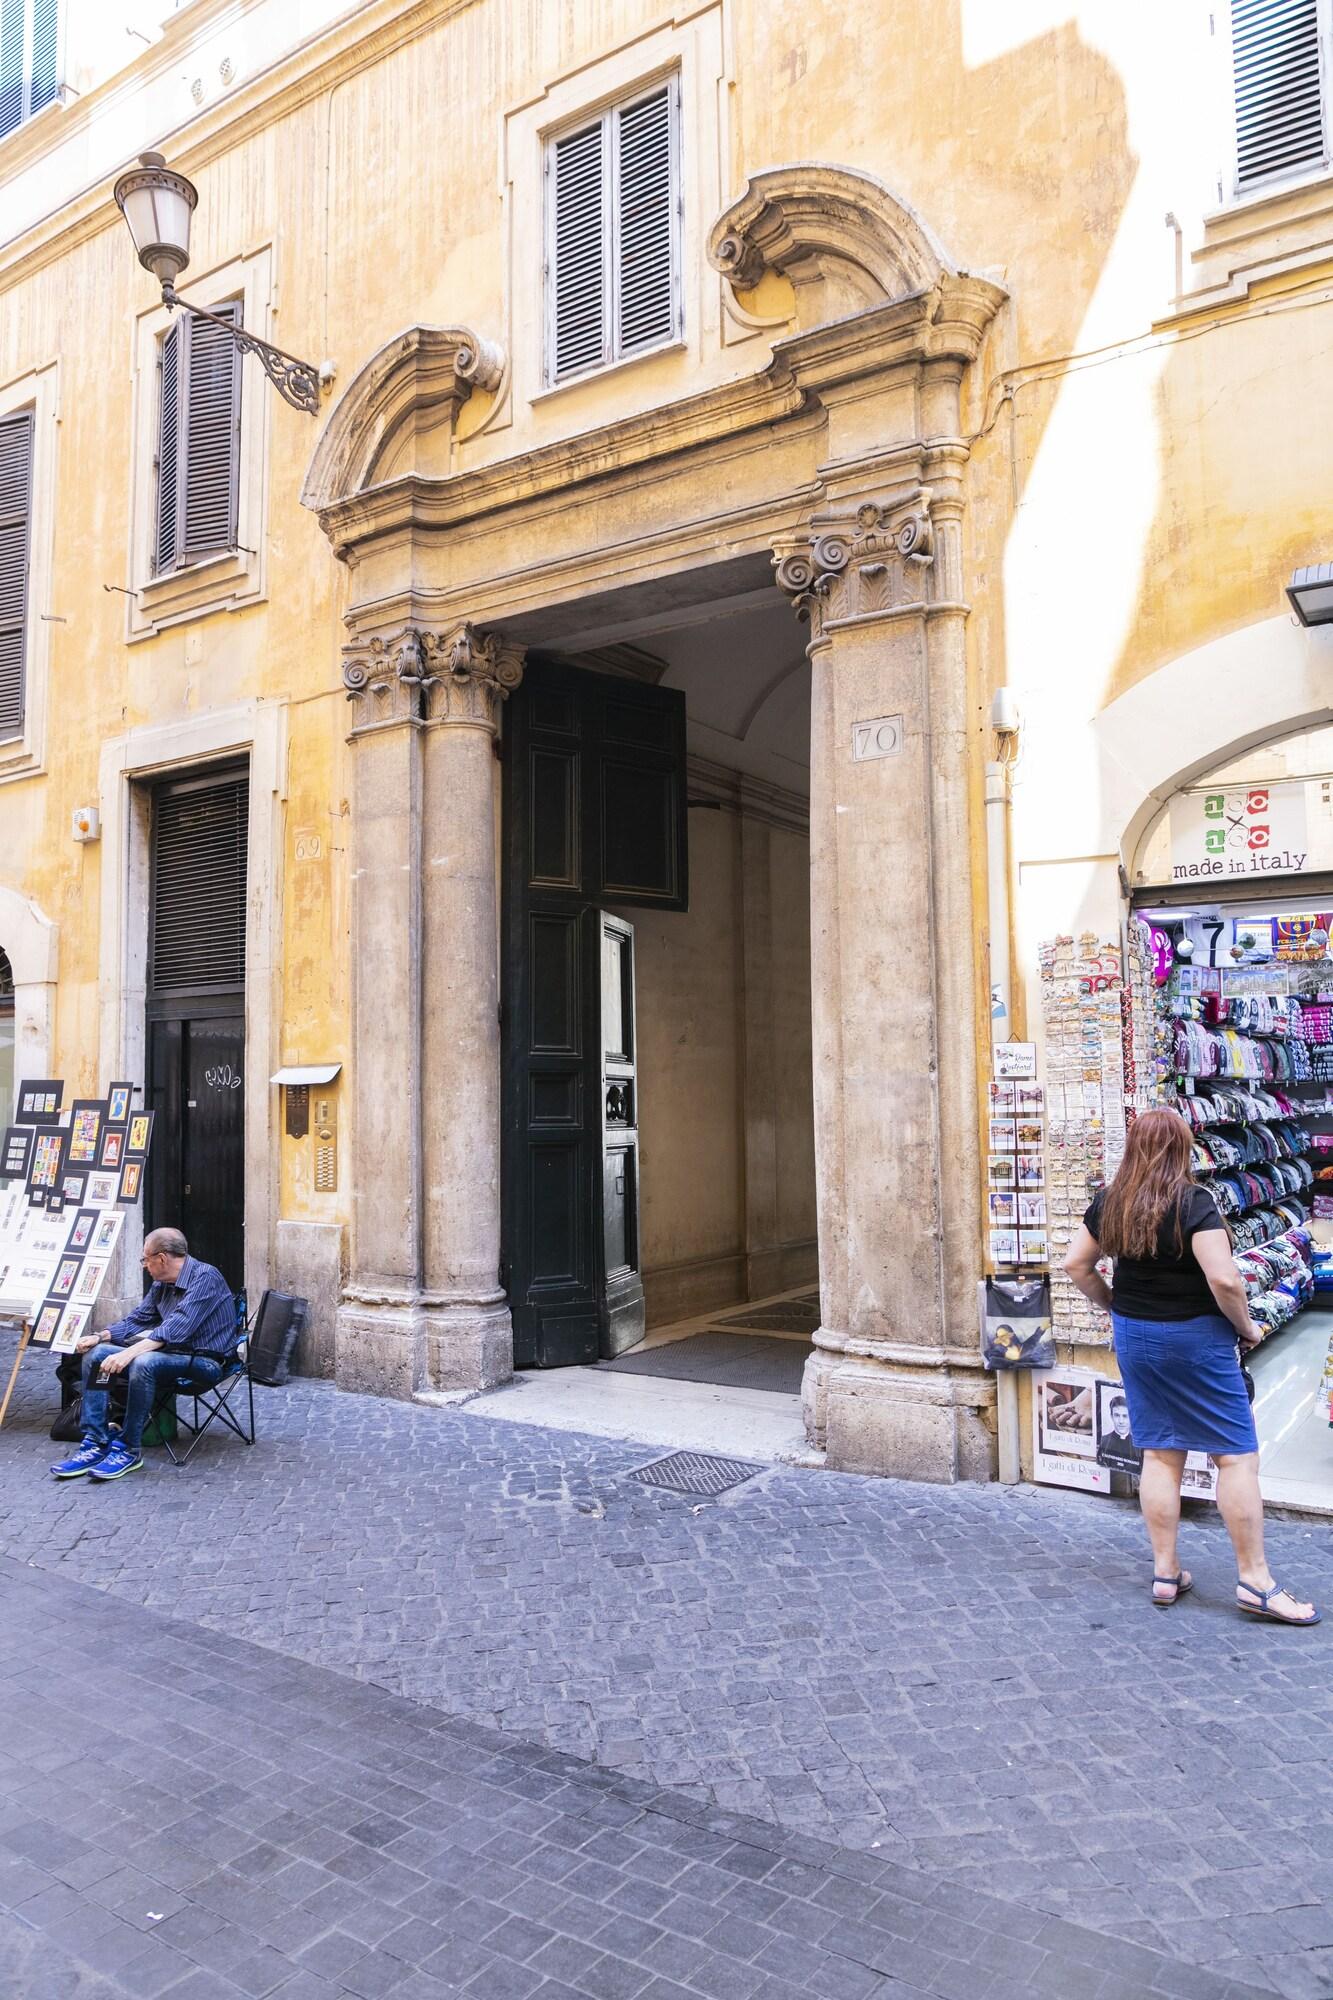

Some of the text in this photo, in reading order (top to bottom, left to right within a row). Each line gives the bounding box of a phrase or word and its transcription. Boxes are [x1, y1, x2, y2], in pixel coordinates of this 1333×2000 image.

[858, 725, 897, 754] 70
[296, 836, 319, 858] 69
[1174, 851, 1307, 879] made in italy
[1202, 922, 1225, 968] 7
[1048, 1460, 1065, 1472] gatti
[1078, 1463, 1101, 1476] Roma
